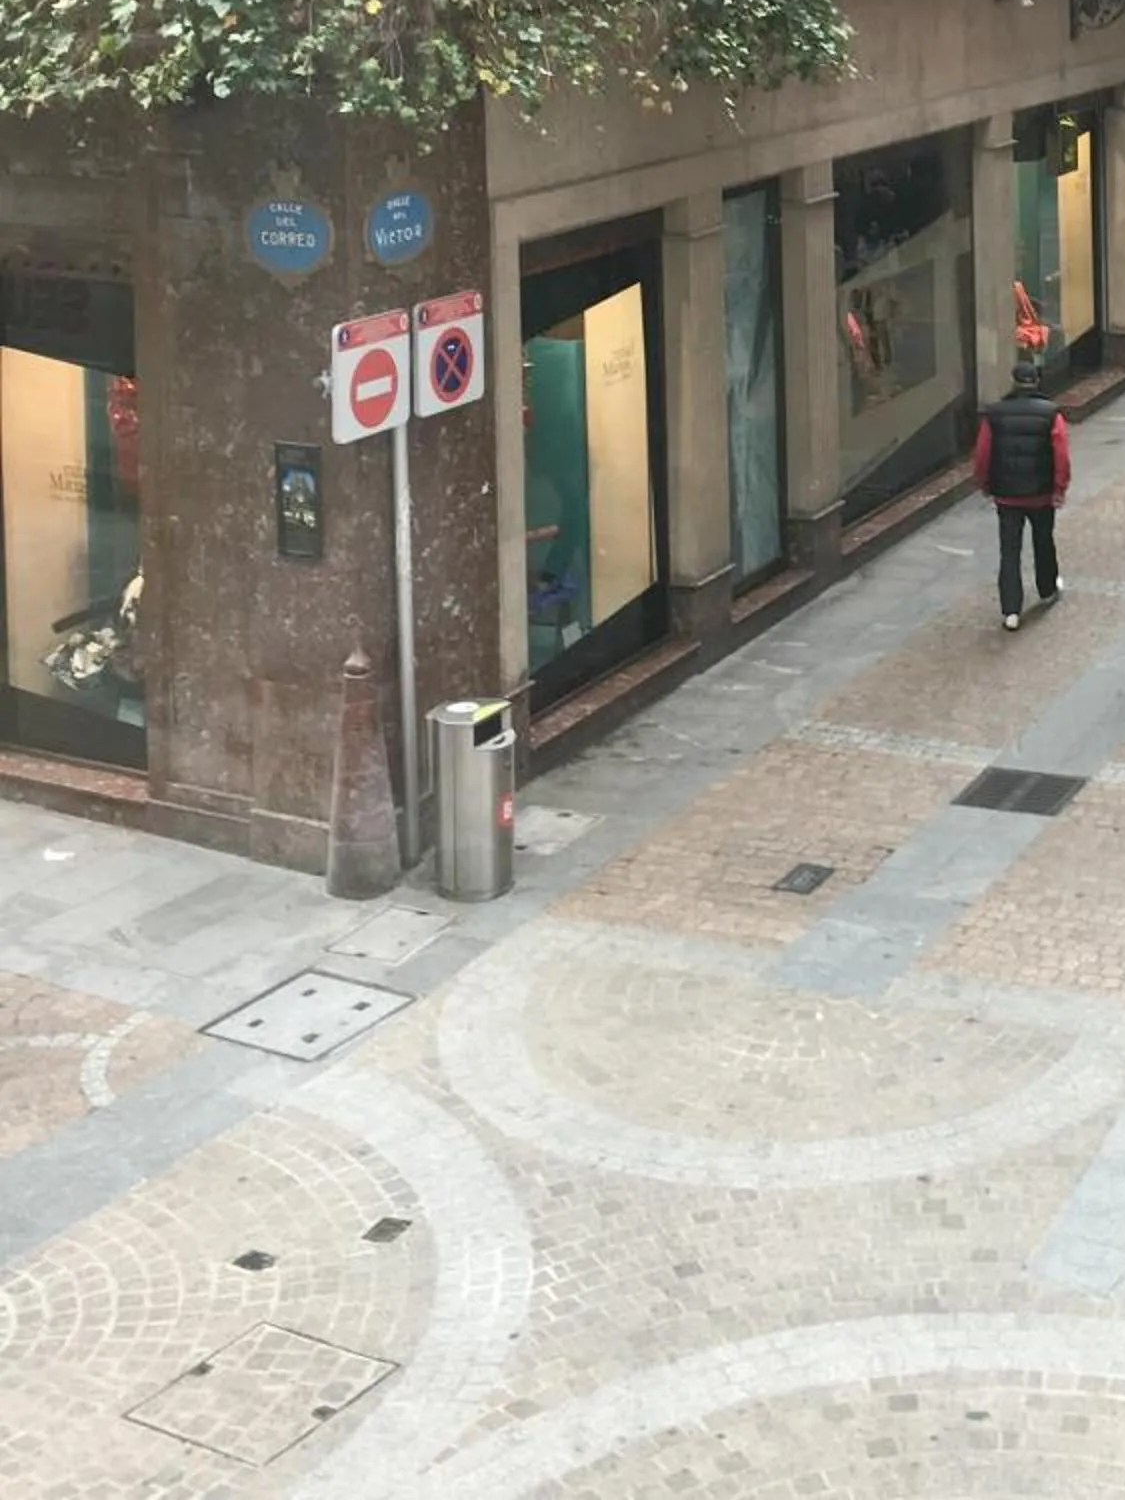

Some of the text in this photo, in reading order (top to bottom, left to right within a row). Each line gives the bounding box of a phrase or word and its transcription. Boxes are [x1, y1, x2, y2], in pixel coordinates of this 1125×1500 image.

[268, 202, 304, 216] CALLE
[275, 216, 297, 228] DEL
[260, 231, 316, 248] CORREO
